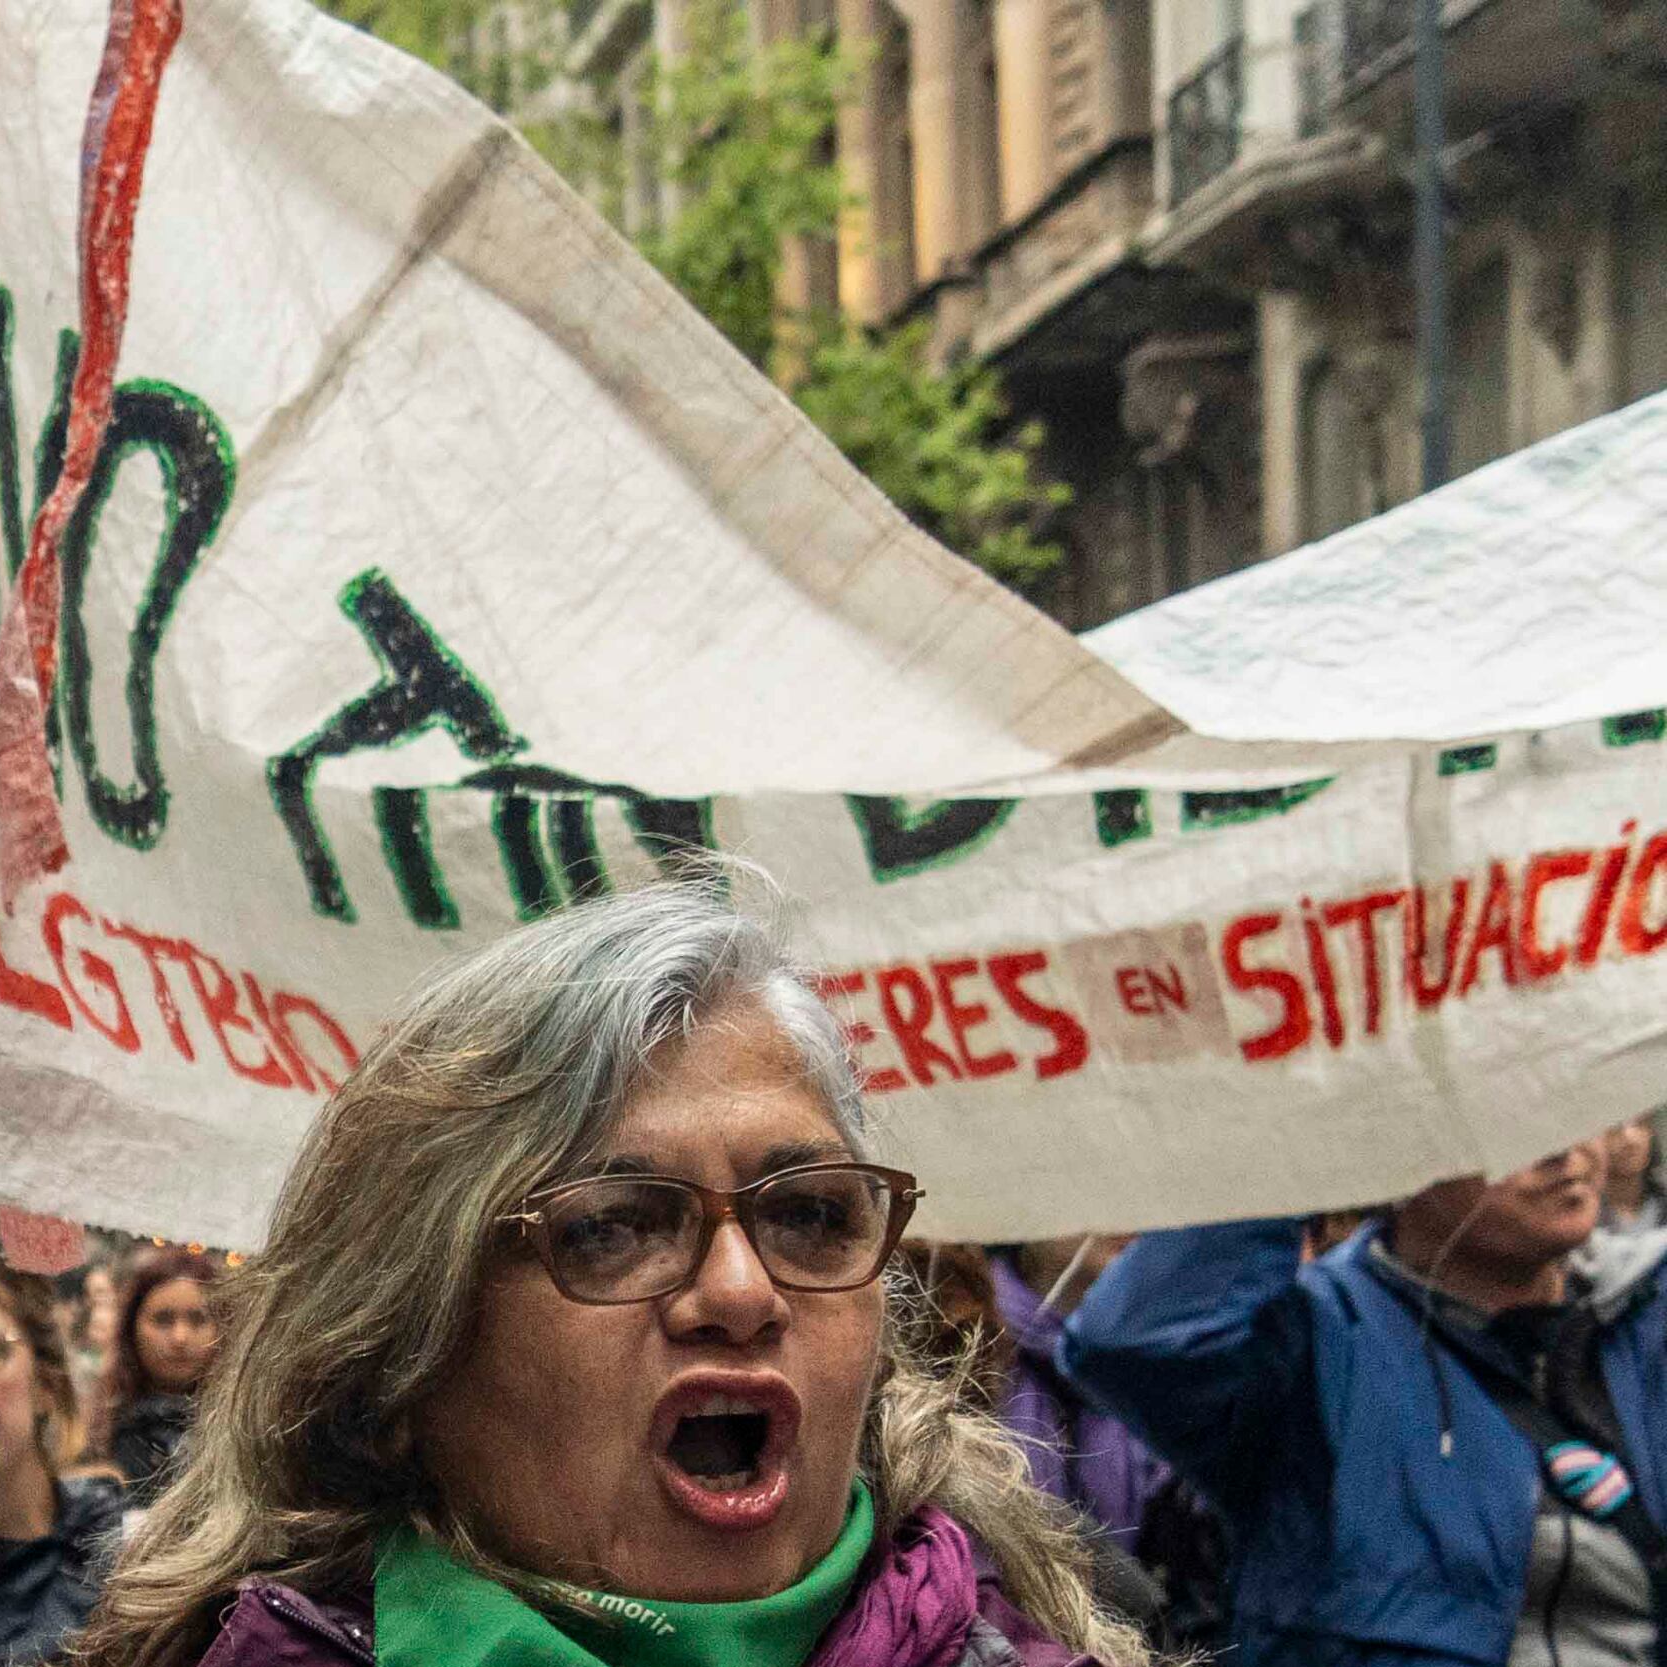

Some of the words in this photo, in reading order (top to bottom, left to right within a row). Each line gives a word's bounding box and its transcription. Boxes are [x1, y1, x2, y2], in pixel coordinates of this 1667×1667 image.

[809, 949, 1090, 1094] ERES
[1114, 960, 1193, 1017] EN
[597, 1593, 677, 1636] morir
